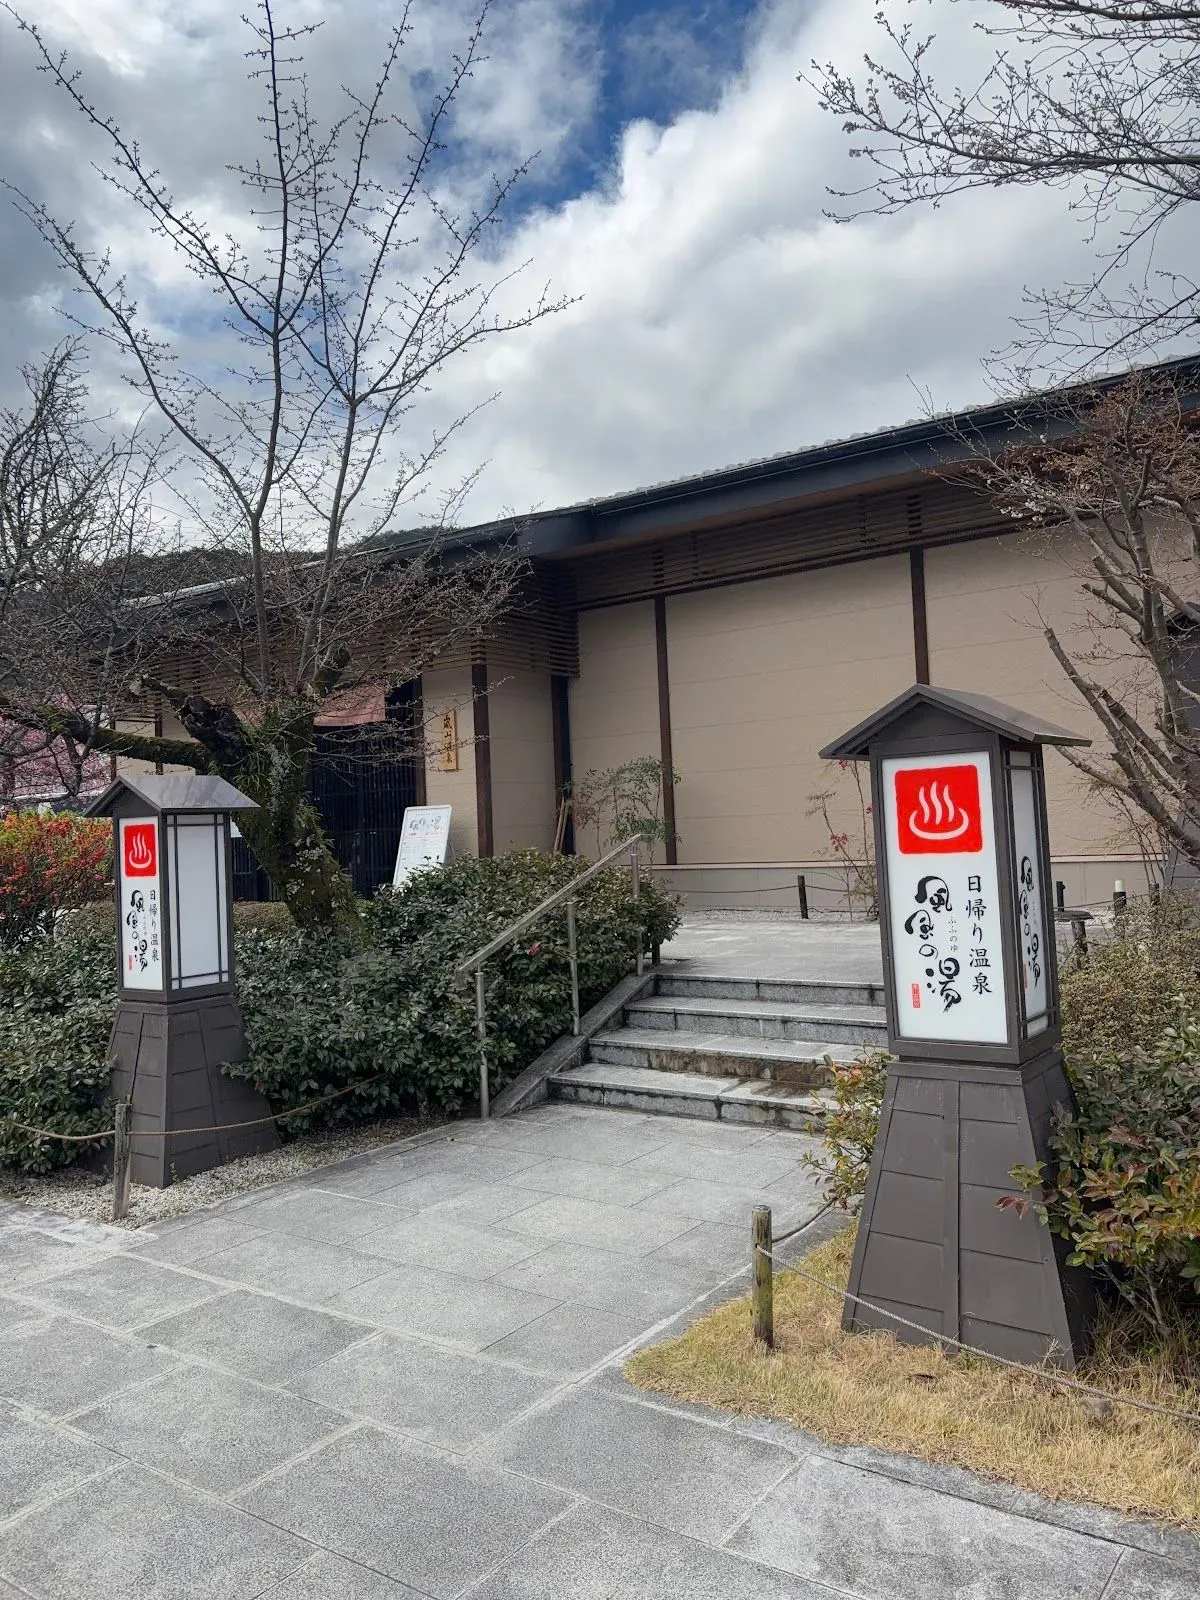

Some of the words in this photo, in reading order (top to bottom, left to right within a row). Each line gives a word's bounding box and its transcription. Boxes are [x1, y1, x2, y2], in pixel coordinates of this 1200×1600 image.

[126, 889, 148, 972] 風風の湯
[150, 889, 159, 962] 日帰り温泉
[904, 875, 962, 1013] 風風の湯
[948, 916, 959, 952] ふふのゆ
[965, 875, 993, 996] 日帰り温泉
